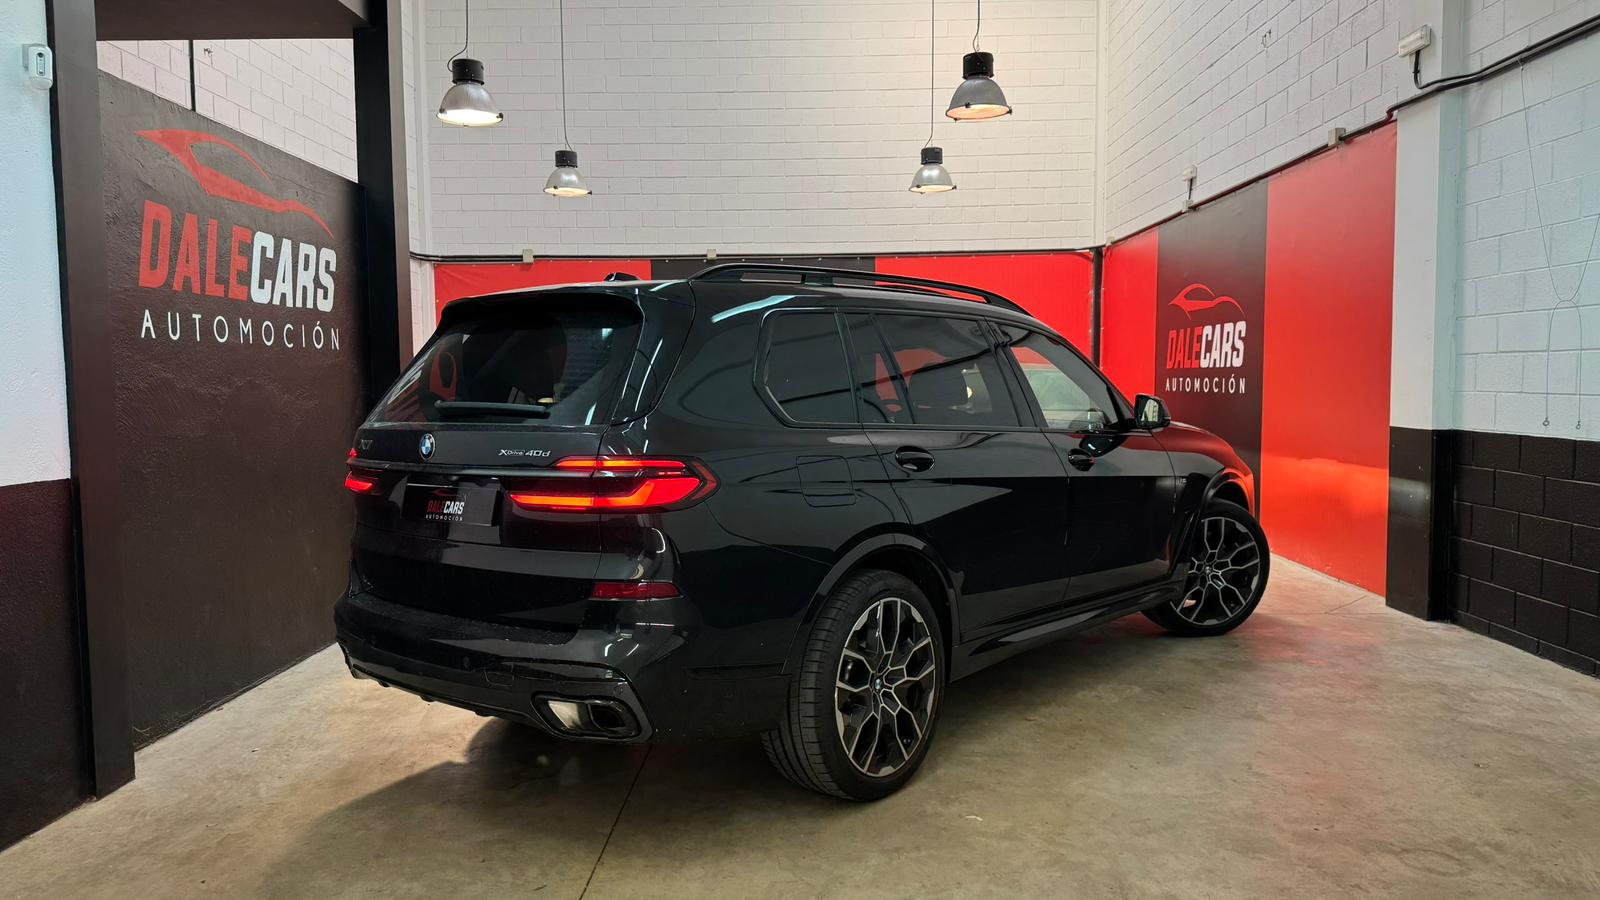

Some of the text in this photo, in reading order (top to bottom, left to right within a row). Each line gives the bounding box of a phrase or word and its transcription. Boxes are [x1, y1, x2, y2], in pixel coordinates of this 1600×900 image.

[138, 199, 337, 313] DALECARS
[140, 308, 340, 350] AUTOMOCIÓN
[1166, 320, 1247, 369] DALECARS
[1165, 374, 1246, 394] AUTOMOCIÓN
[525, 449, 551, 457] 40d
[425, 513, 463, 522] AUTOMOCIÓN
